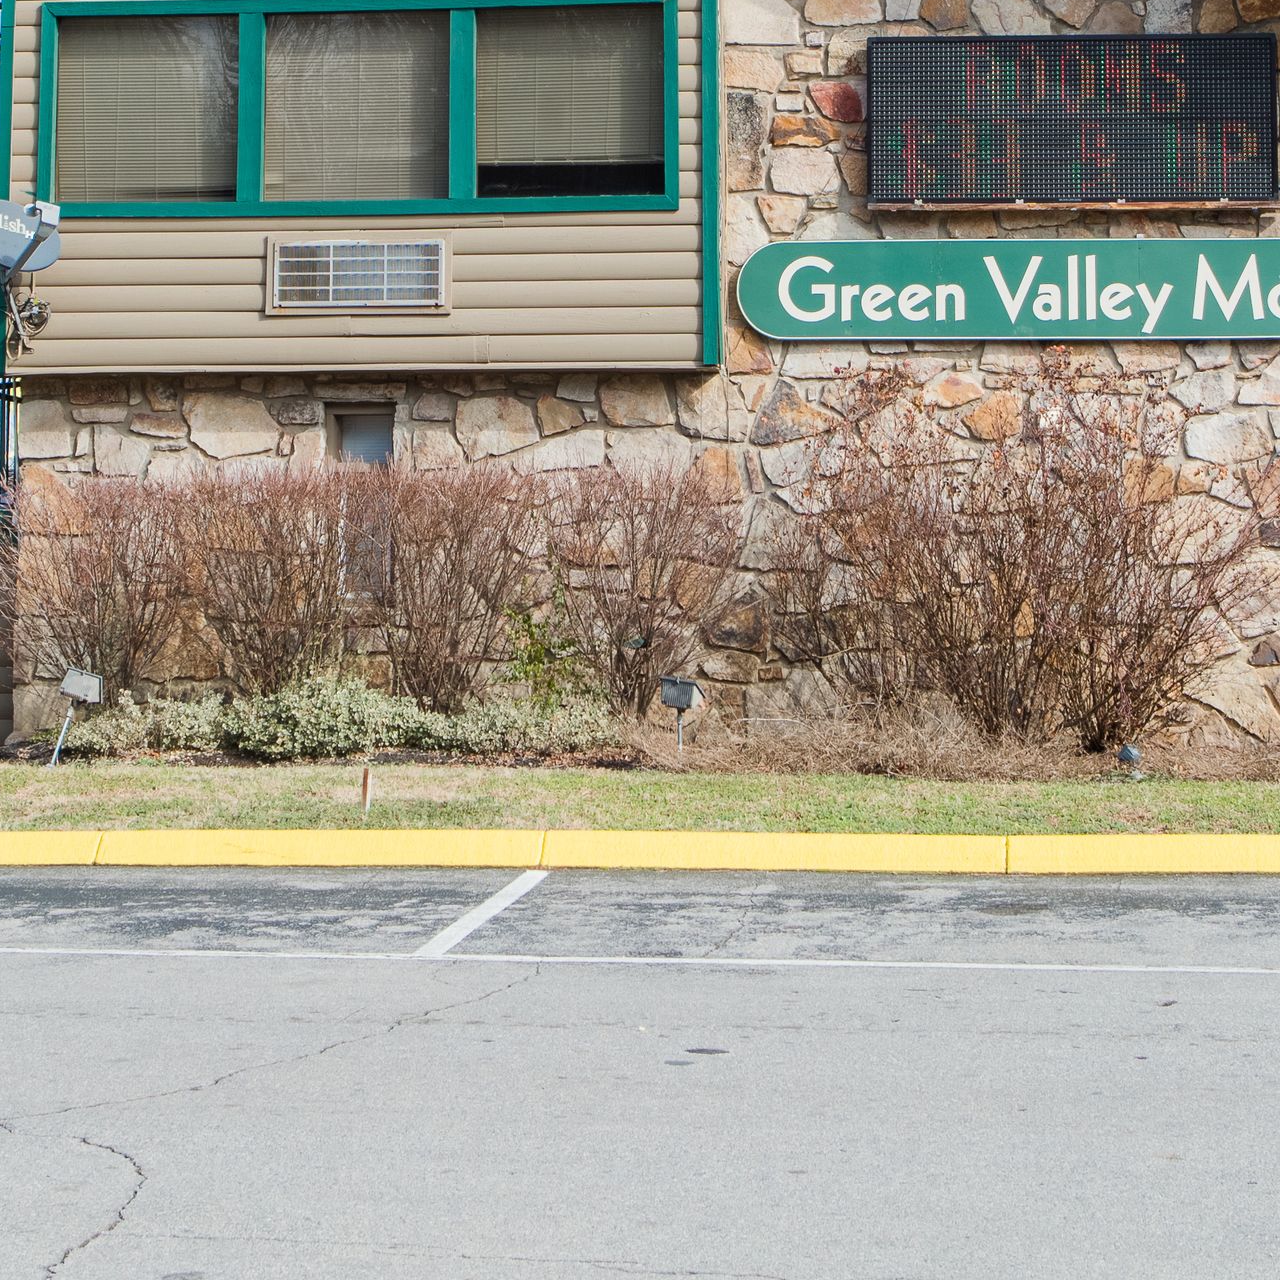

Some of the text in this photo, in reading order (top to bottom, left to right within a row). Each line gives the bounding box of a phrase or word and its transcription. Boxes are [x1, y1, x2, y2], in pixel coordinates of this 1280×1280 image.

[962, 43, 1186, 113] ROOMS
[1167, 122, 1258, 193] UP
[777, 255, 966, 323] Green
[982, 254, 1174, 334] Valley
